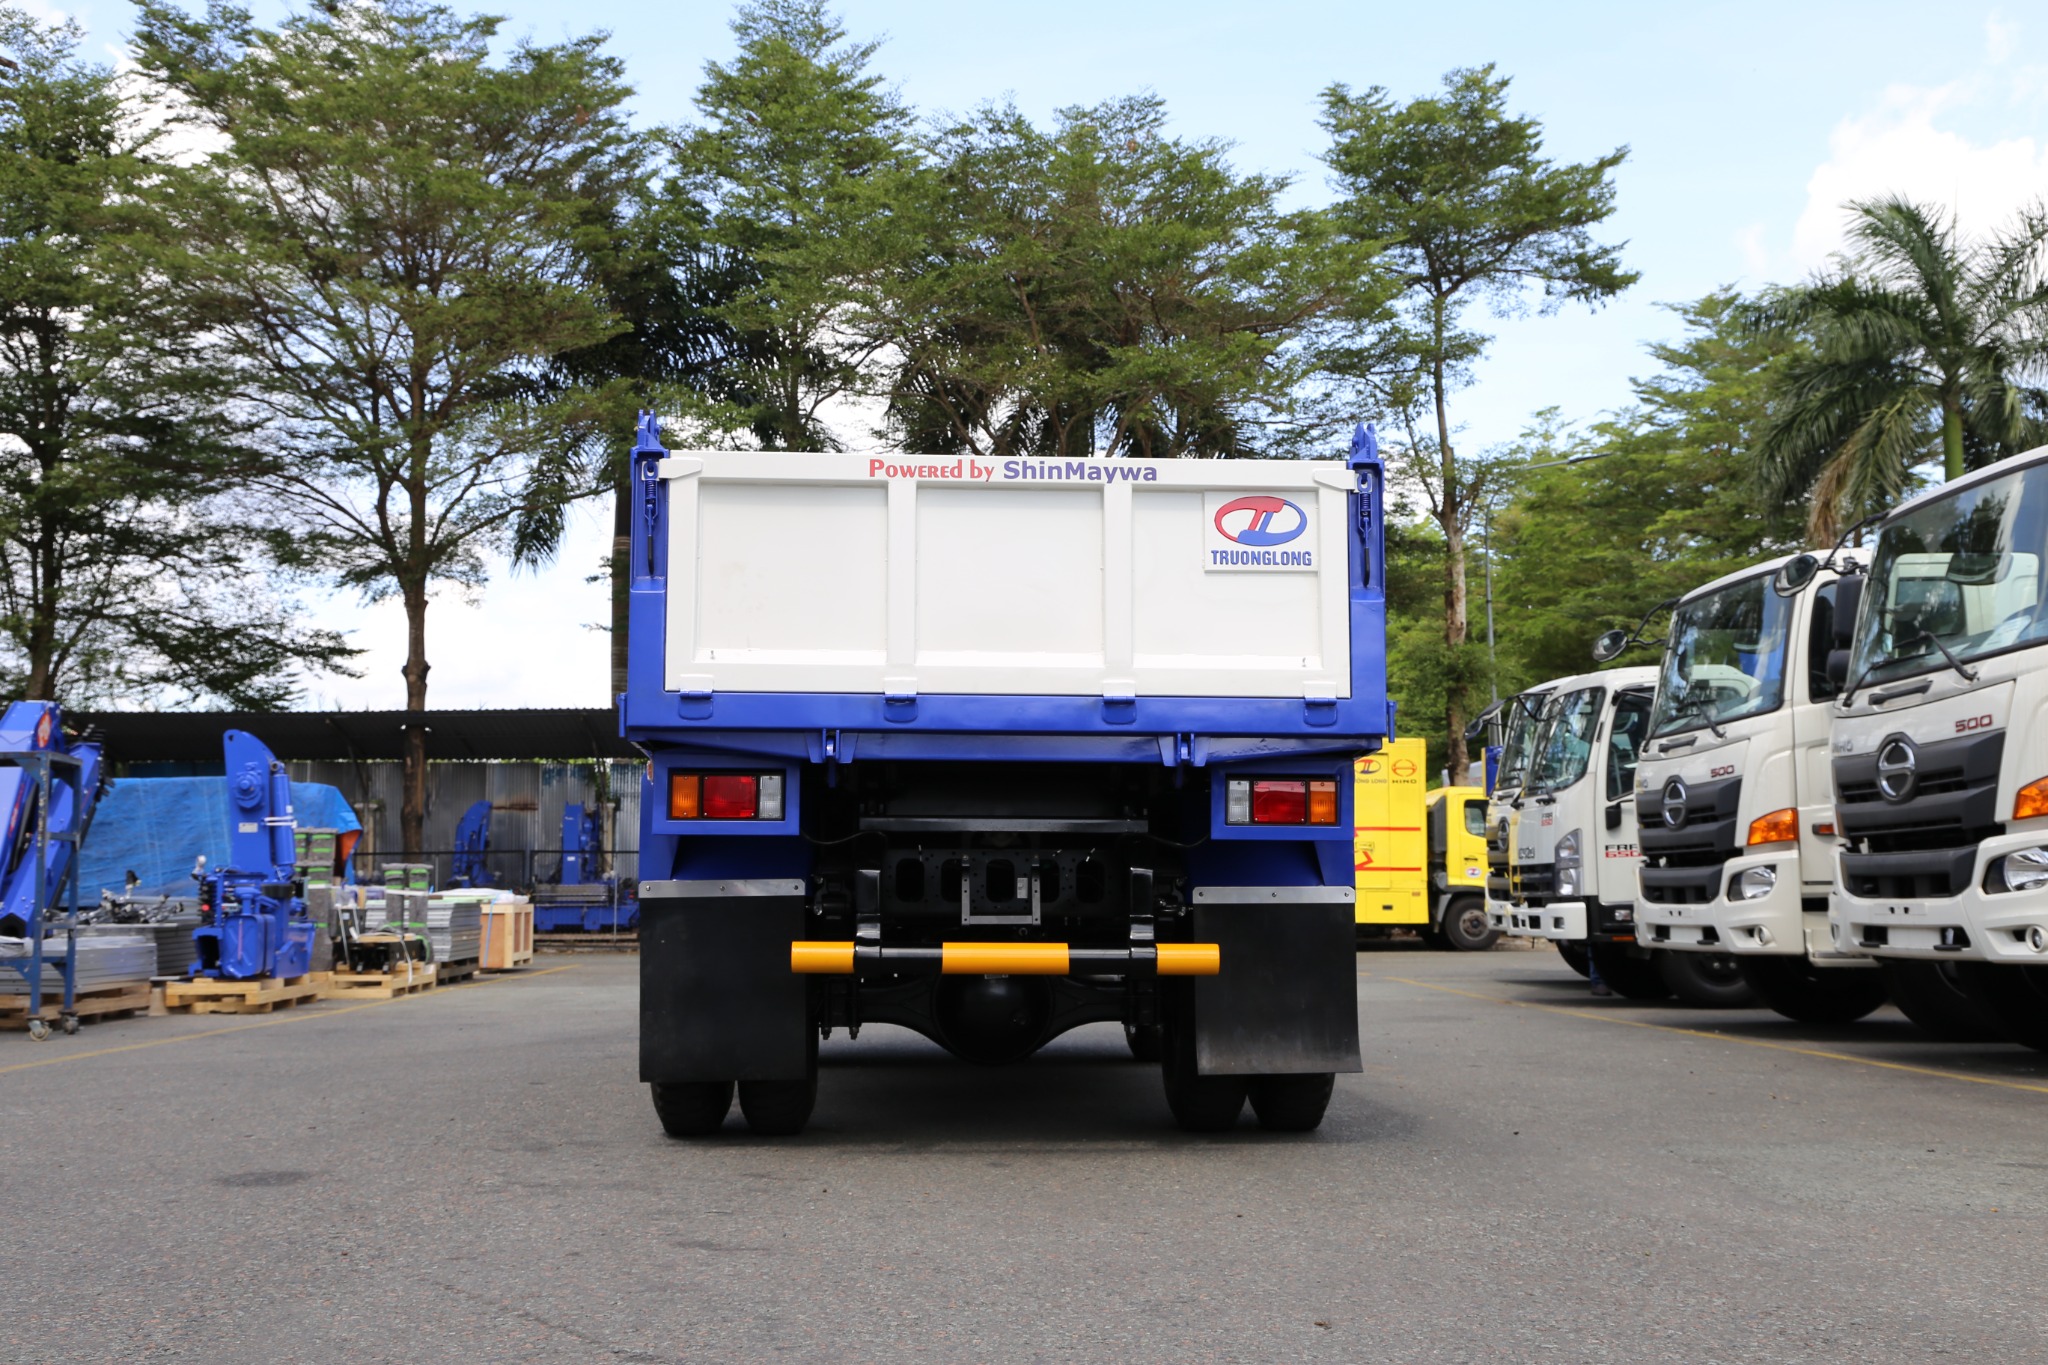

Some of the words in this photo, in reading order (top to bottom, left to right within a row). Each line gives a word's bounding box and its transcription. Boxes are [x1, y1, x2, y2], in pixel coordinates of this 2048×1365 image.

[969, 459, 995, 482] by
[1003, 460, 1158, 484] ShinMaywa
[1211, 549, 1312, 566] TRUONGLONG
[1955, 714, 1993, 733] 500
[1711, 764, 1735, 778] 500
